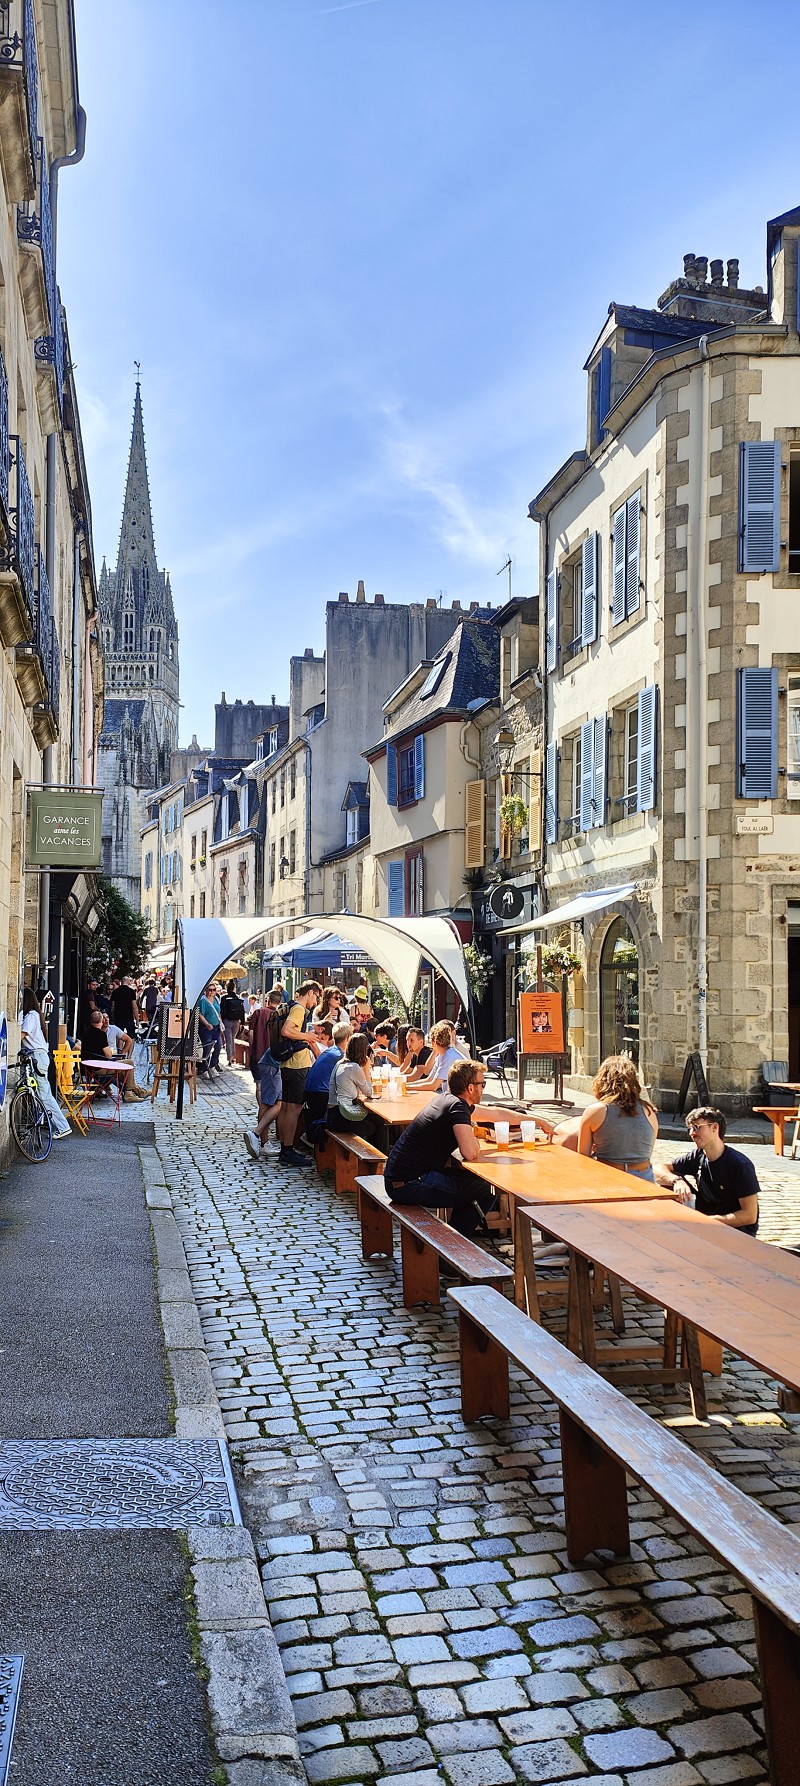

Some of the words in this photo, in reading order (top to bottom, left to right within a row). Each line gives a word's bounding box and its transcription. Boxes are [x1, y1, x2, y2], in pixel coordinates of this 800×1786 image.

[42, 815, 90, 825] GARANCE
[70, 826, 80, 835] les
[40, 836, 91, 846] VACANCES
